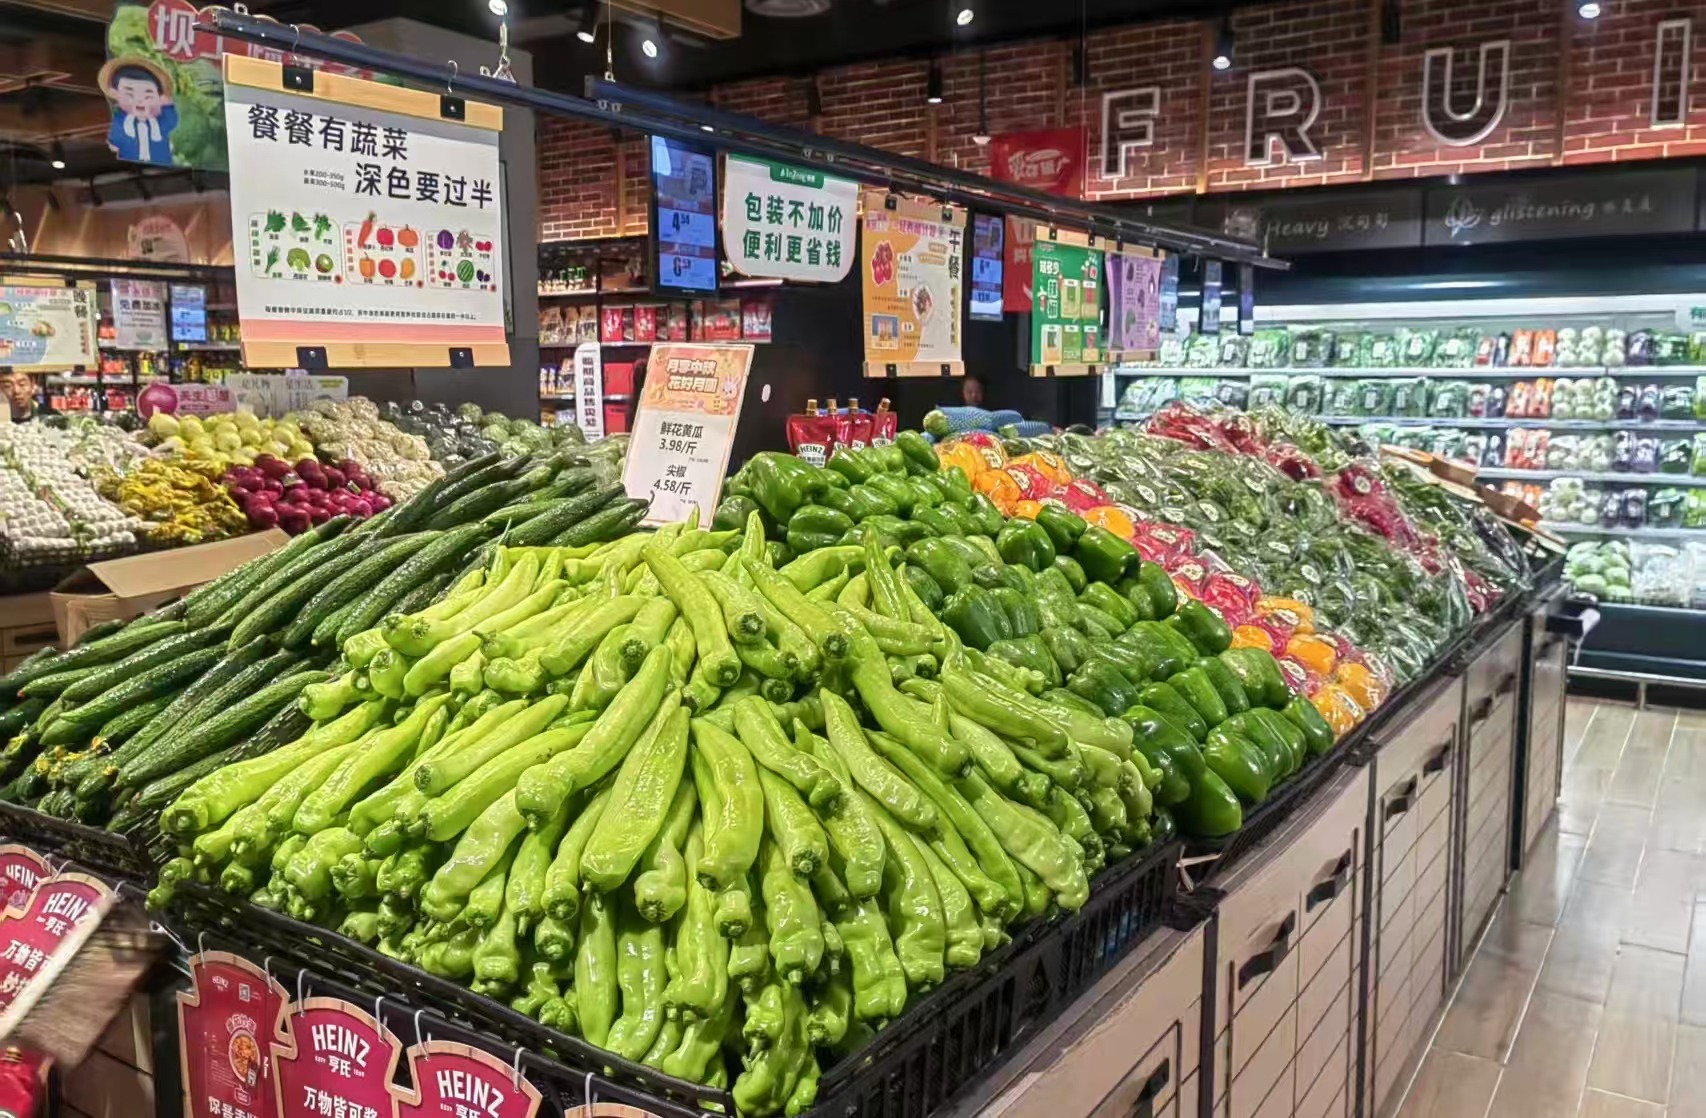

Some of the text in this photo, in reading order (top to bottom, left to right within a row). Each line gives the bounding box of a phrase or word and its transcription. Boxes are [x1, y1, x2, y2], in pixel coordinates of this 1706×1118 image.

[248, 103, 408, 160] 餐餐有蔬菜
[355, 161, 493, 209] 深色要过半
[744, 191, 843, 234] 包装不加价
[1489, 200, 1595, 226] glistening
[1265, 219, 1329, 238] Heavy
[742, 228, 842, 268] 便利更省钱
[659, 421, 704, 439] 鲜花黄瓜
[658, 438, 698, 455] 3.98/斤
[800, 444, 823, 454] HEINZ
[653, 478, 692, 495] 4.58/斤
[211, 975, 229, 988] HEINZ
[311, 1024, 371, 1068] HEINZ
[328, 1055, 351, 1078] 亨氏
[436, 1070, 504, 1118] HEINZ
